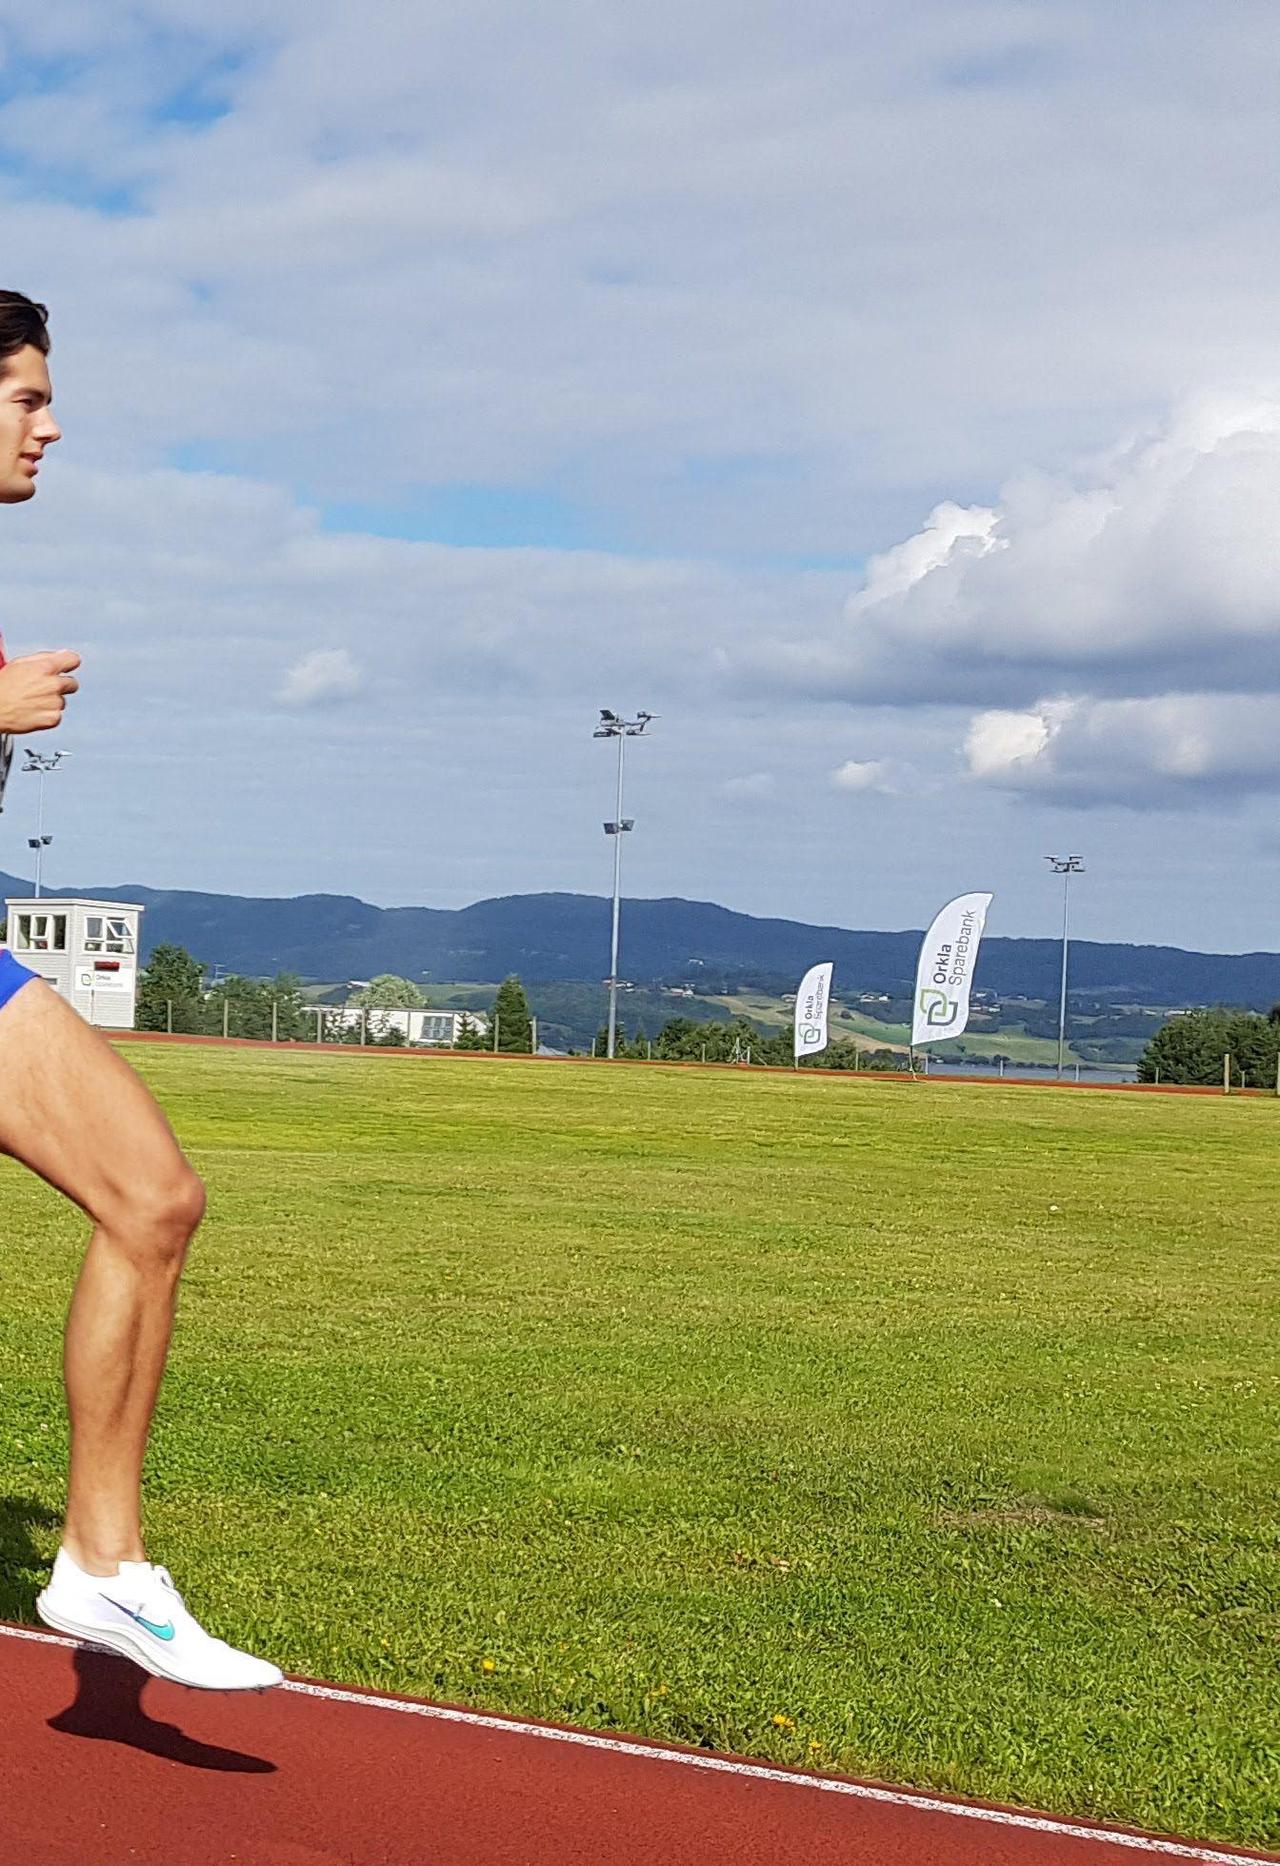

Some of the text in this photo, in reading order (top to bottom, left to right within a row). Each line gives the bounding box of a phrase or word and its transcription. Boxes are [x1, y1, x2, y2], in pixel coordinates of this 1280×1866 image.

[933, 944, 952, 984] Orkla
[948, 910, 976, 986] Sparebank
[804, 995, 814, 1020] Orkla
